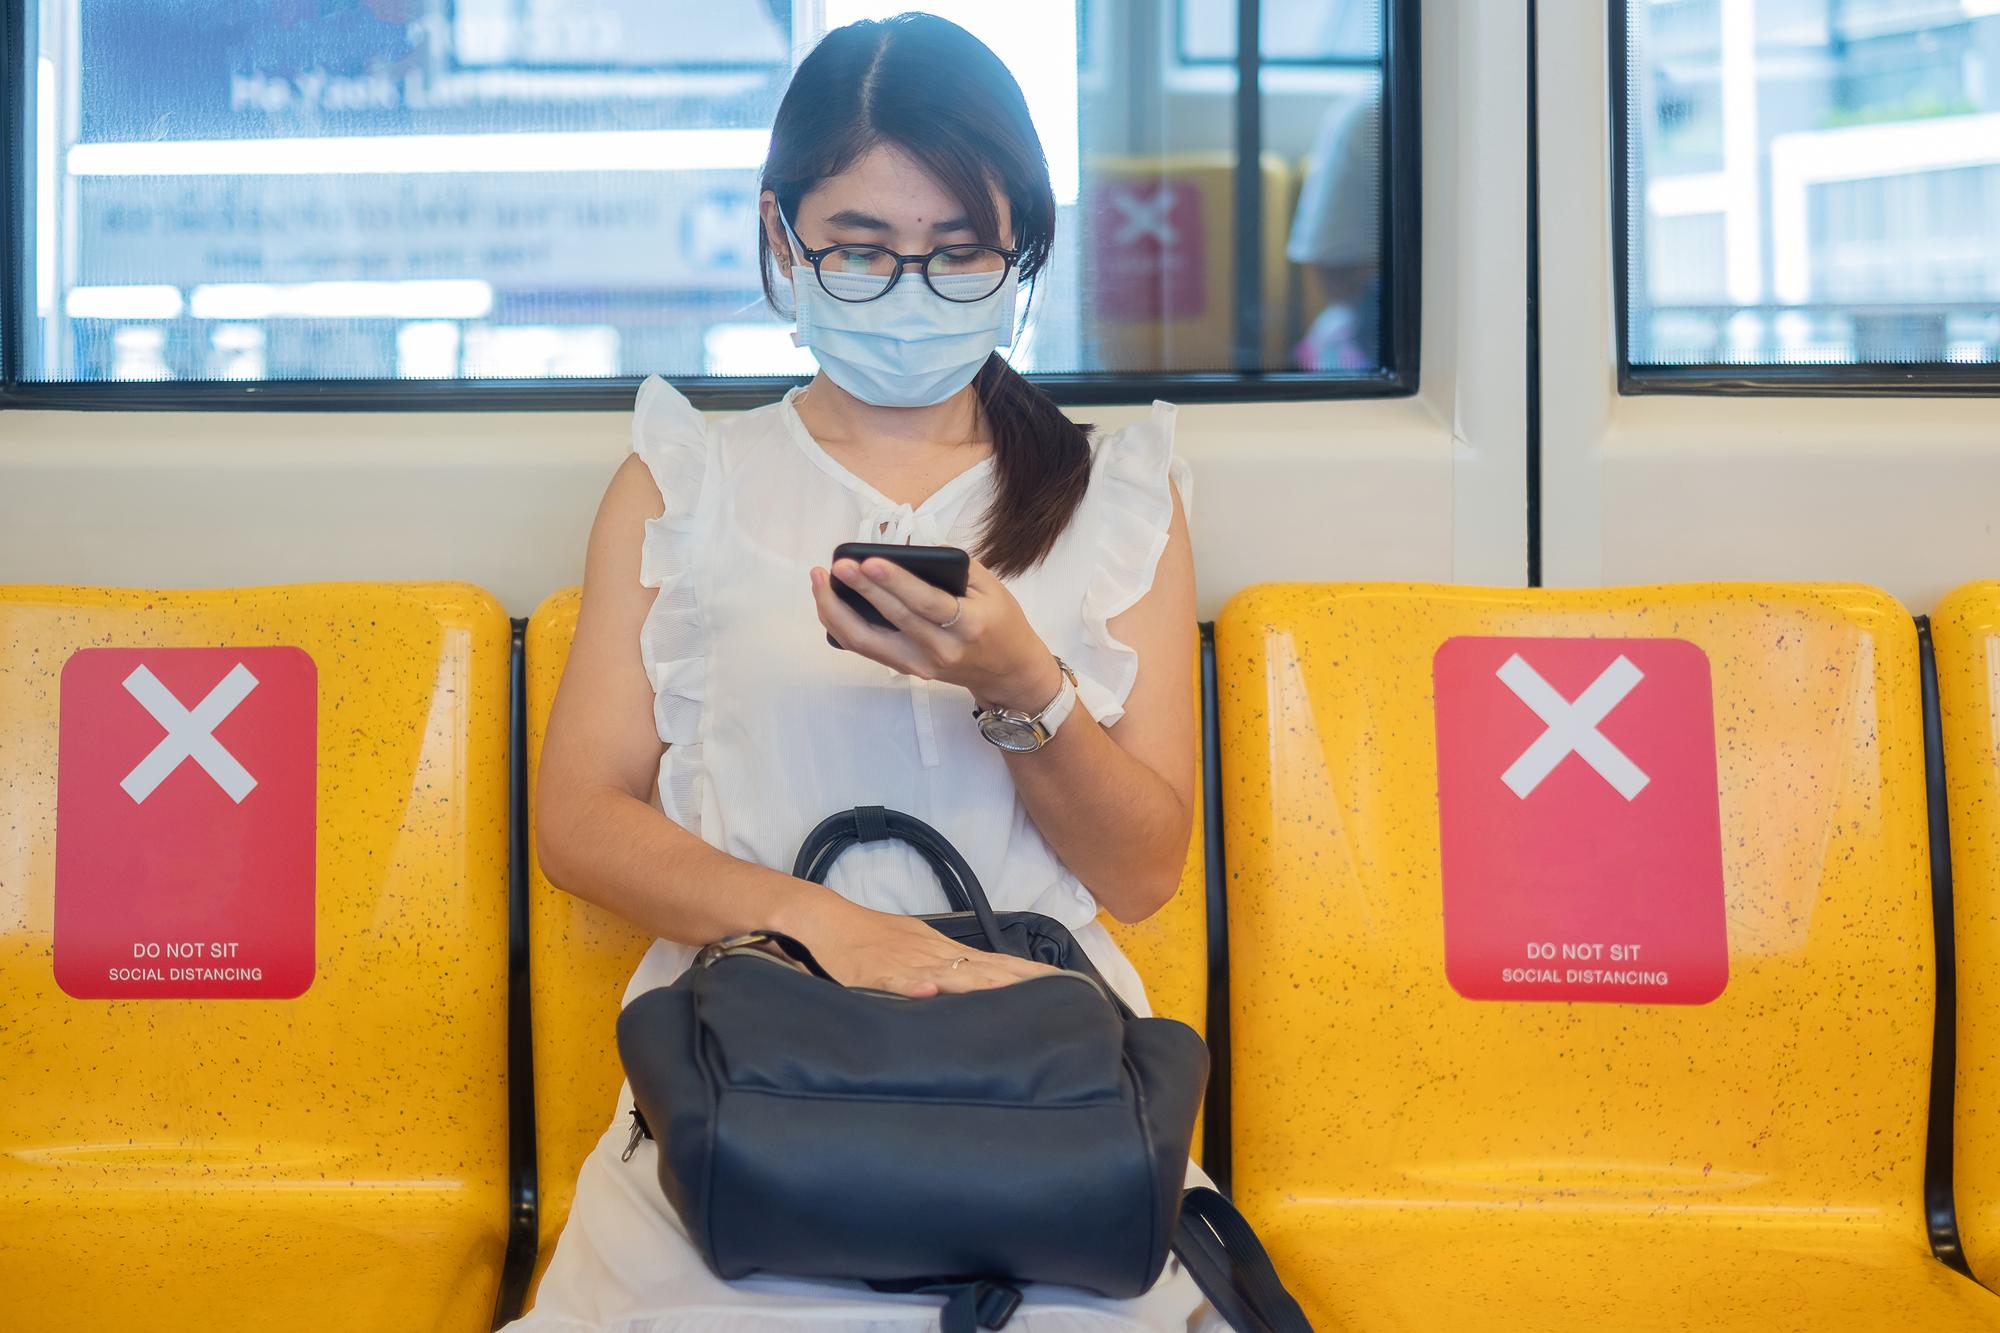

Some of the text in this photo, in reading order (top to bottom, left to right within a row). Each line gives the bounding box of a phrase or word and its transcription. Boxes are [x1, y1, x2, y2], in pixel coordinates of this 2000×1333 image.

[133, 942, 240, 959] DO NOT SIT
[1526, 942, 1642, 962] DO NOT SIT
[108, 967, 263, 982] SOCIAL DISTANCING
[1501, 967, 1669, 987] SOCIAL DISTANCING
